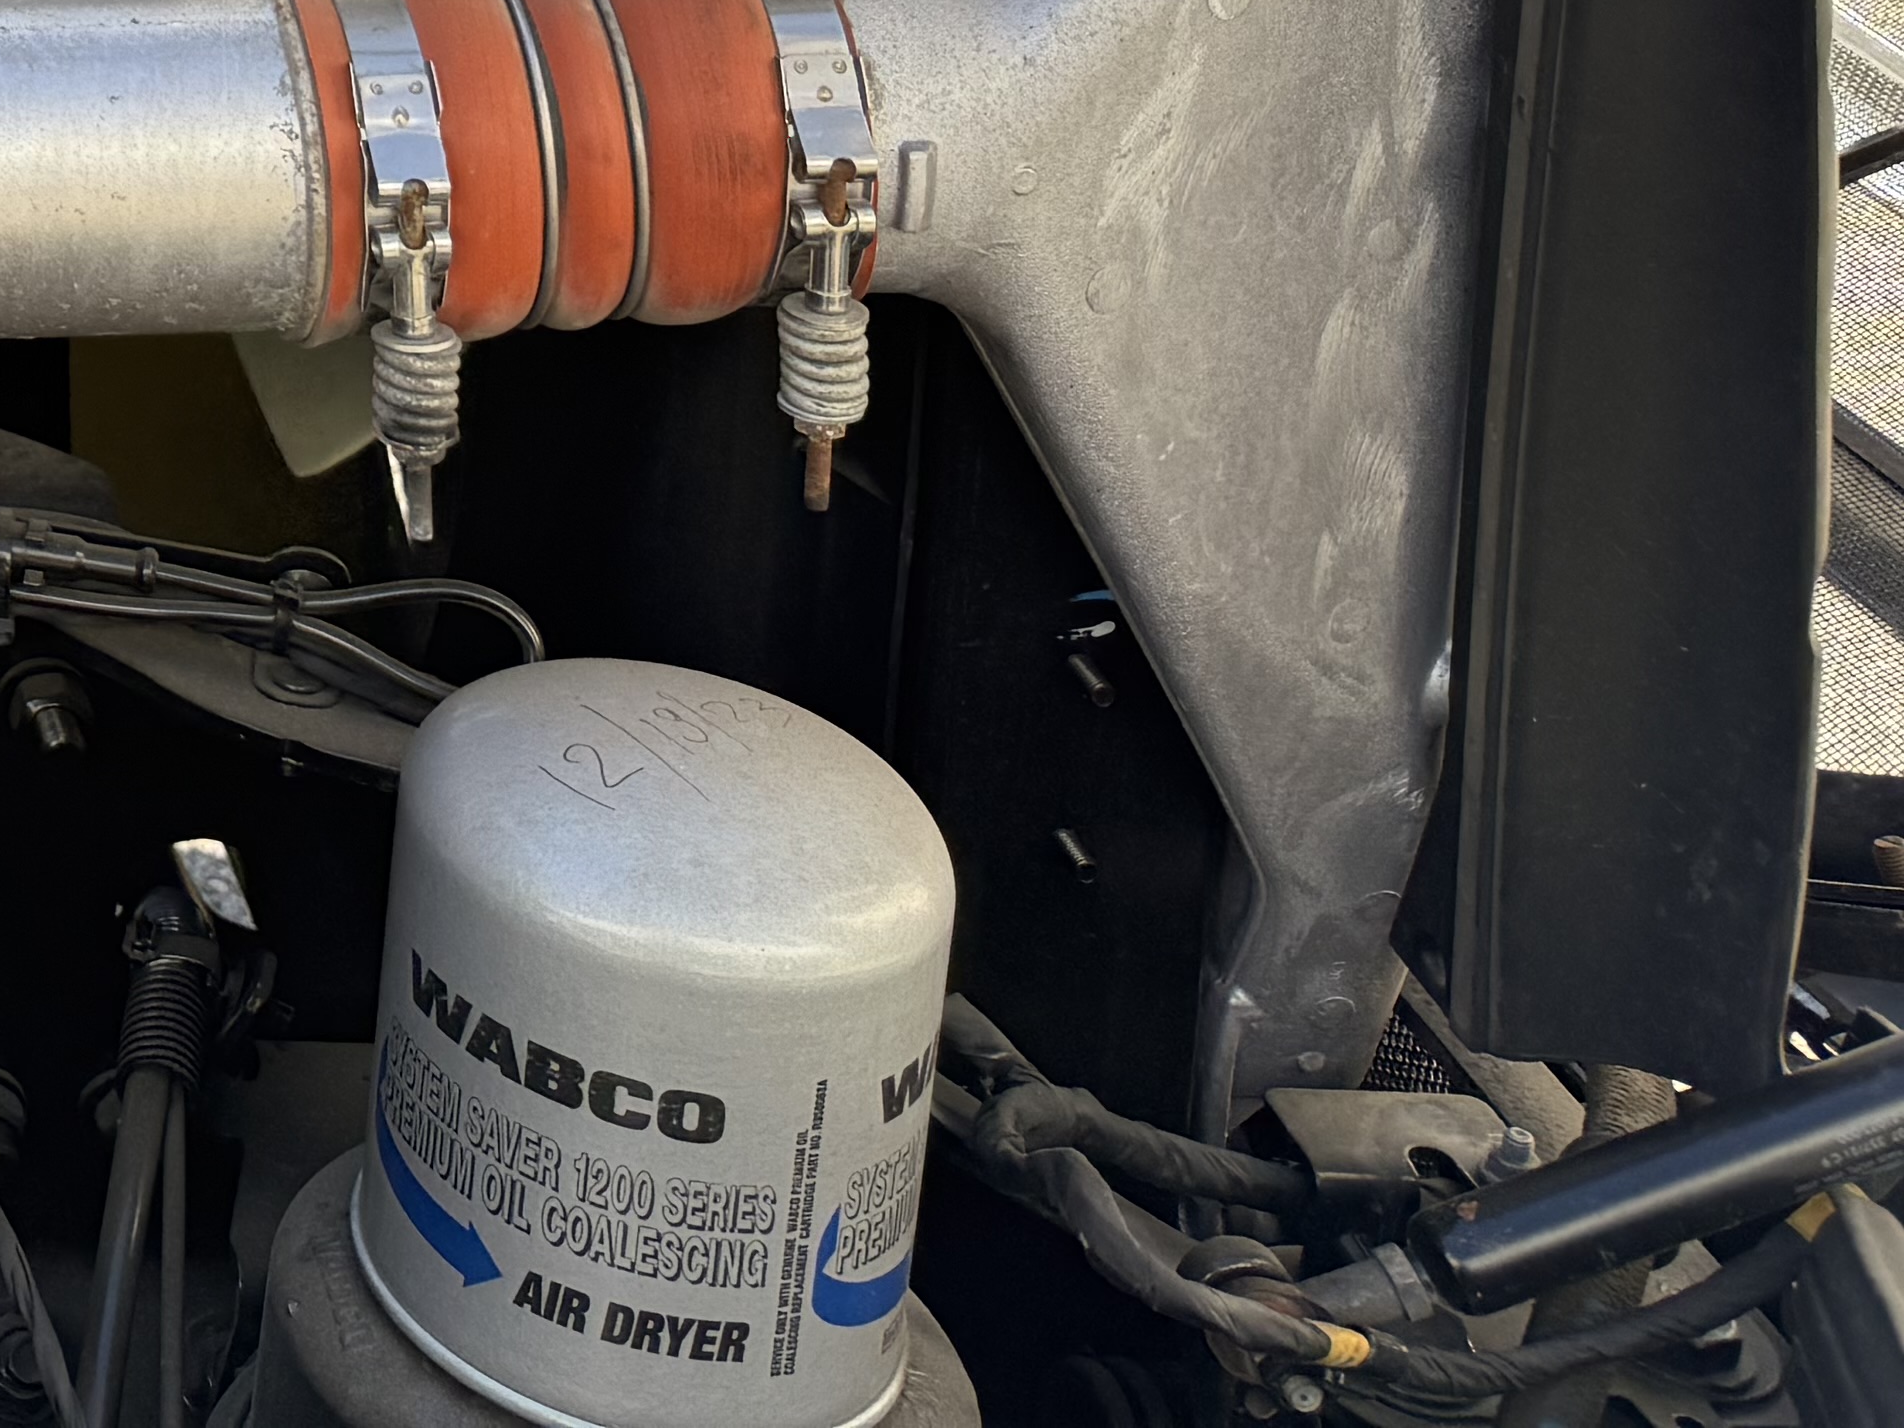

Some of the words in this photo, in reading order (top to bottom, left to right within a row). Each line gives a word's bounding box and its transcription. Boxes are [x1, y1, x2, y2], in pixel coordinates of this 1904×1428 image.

[411, 947, 726, 1144] WABCO
[389, 1015, 462, 1136] SYSTEM
[464, 1096, 562, 1192] SAVER
[574, 1151, 655, 1220] 1200
[662, 1177, 778, 1235] SERIES
[796, 1128, 809, 1146] OIL
[383, 1070, 475, 1200] PREMIUM
[480, 1163, 532, 1235] OIL
[540, 1195, 769, 1288] COALESCING
[790, 1147, 806, 1195] PREMIUM
[805, 1153, 820, 1180] PART
[786, 1198, 801, 1234] WABCO
[799, 1181, 817, 1240] CARTRIDGE
[778, 1283, 792, 1309] WITH
[790, 1245, 809, 1314] REPLACEMENT
[512, 1270, 592, 1334] AIR
[600, 1301, 751, 1363] DRYER
[775, 1310, 788, 1336] ONLY
[770, 1337, 786, 1378] SERVICE
[783, 1315, 801, 1376] COALESCING
